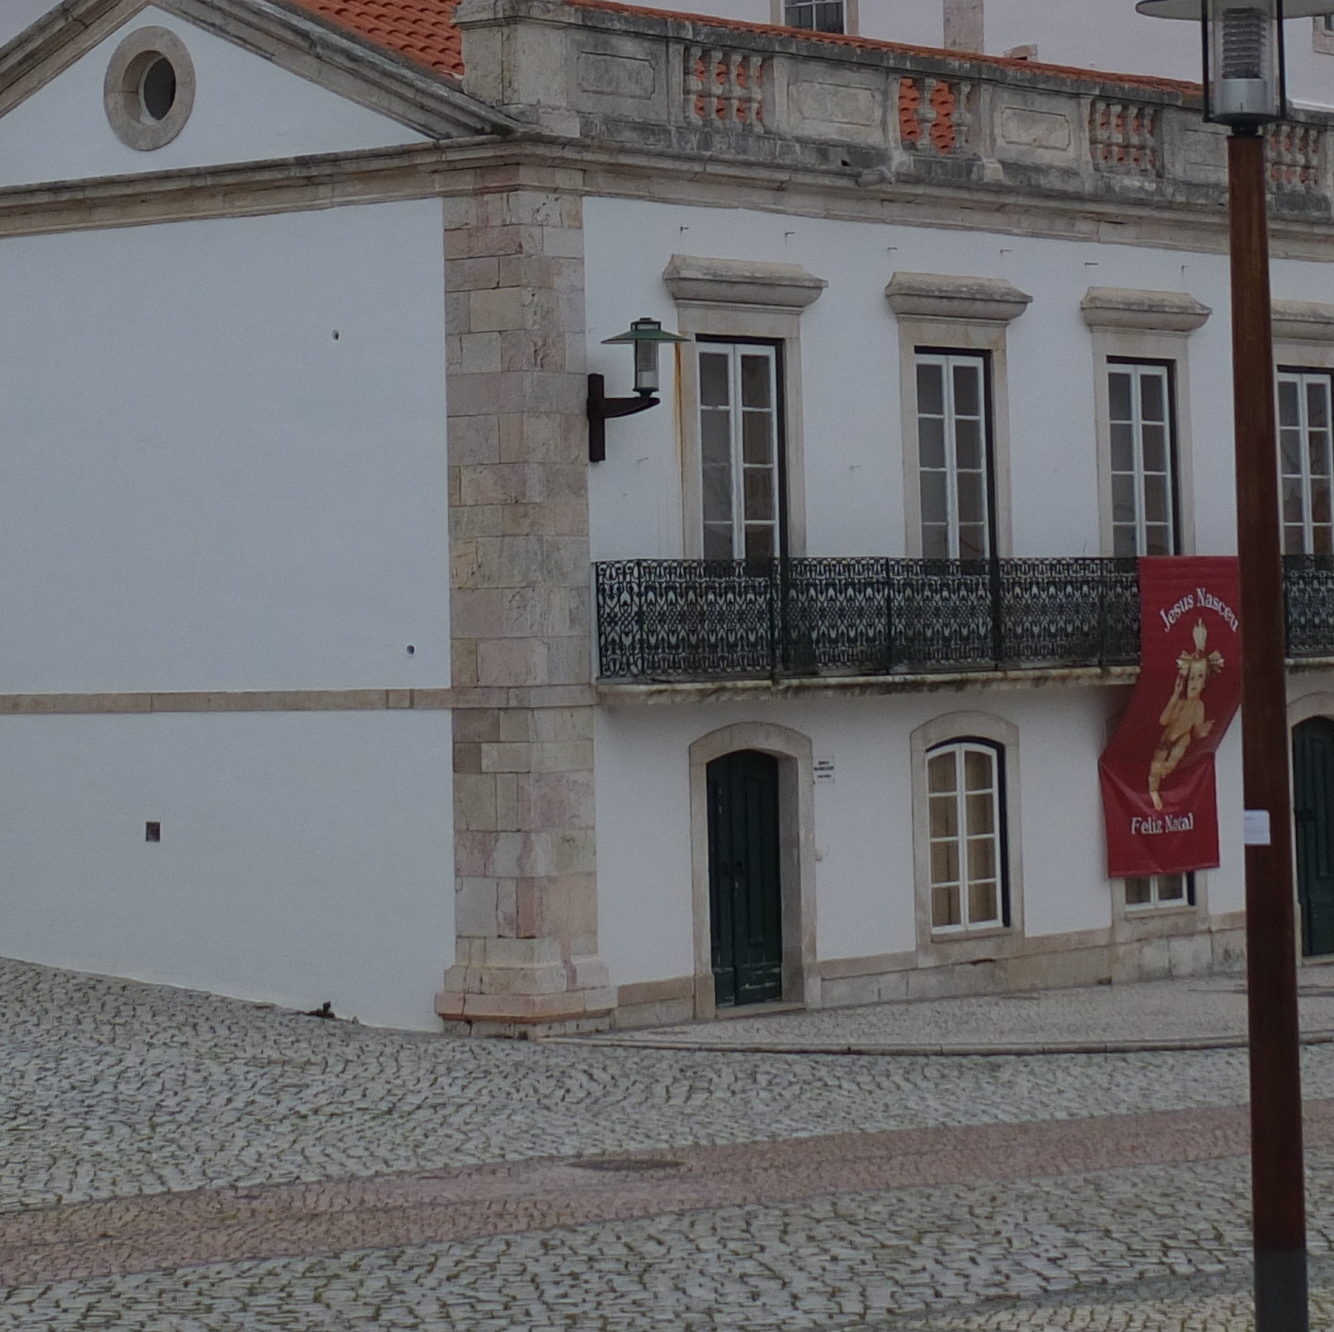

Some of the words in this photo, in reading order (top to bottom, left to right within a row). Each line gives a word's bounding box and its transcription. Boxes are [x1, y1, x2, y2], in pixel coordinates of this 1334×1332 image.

[1159, 594, 1194, 633] Jesus
[1196, 587, 1239, 633] Nasceu
[1131, 816, 1163, 835] Feliz
[1165, 812, 1194, 833] Natal
